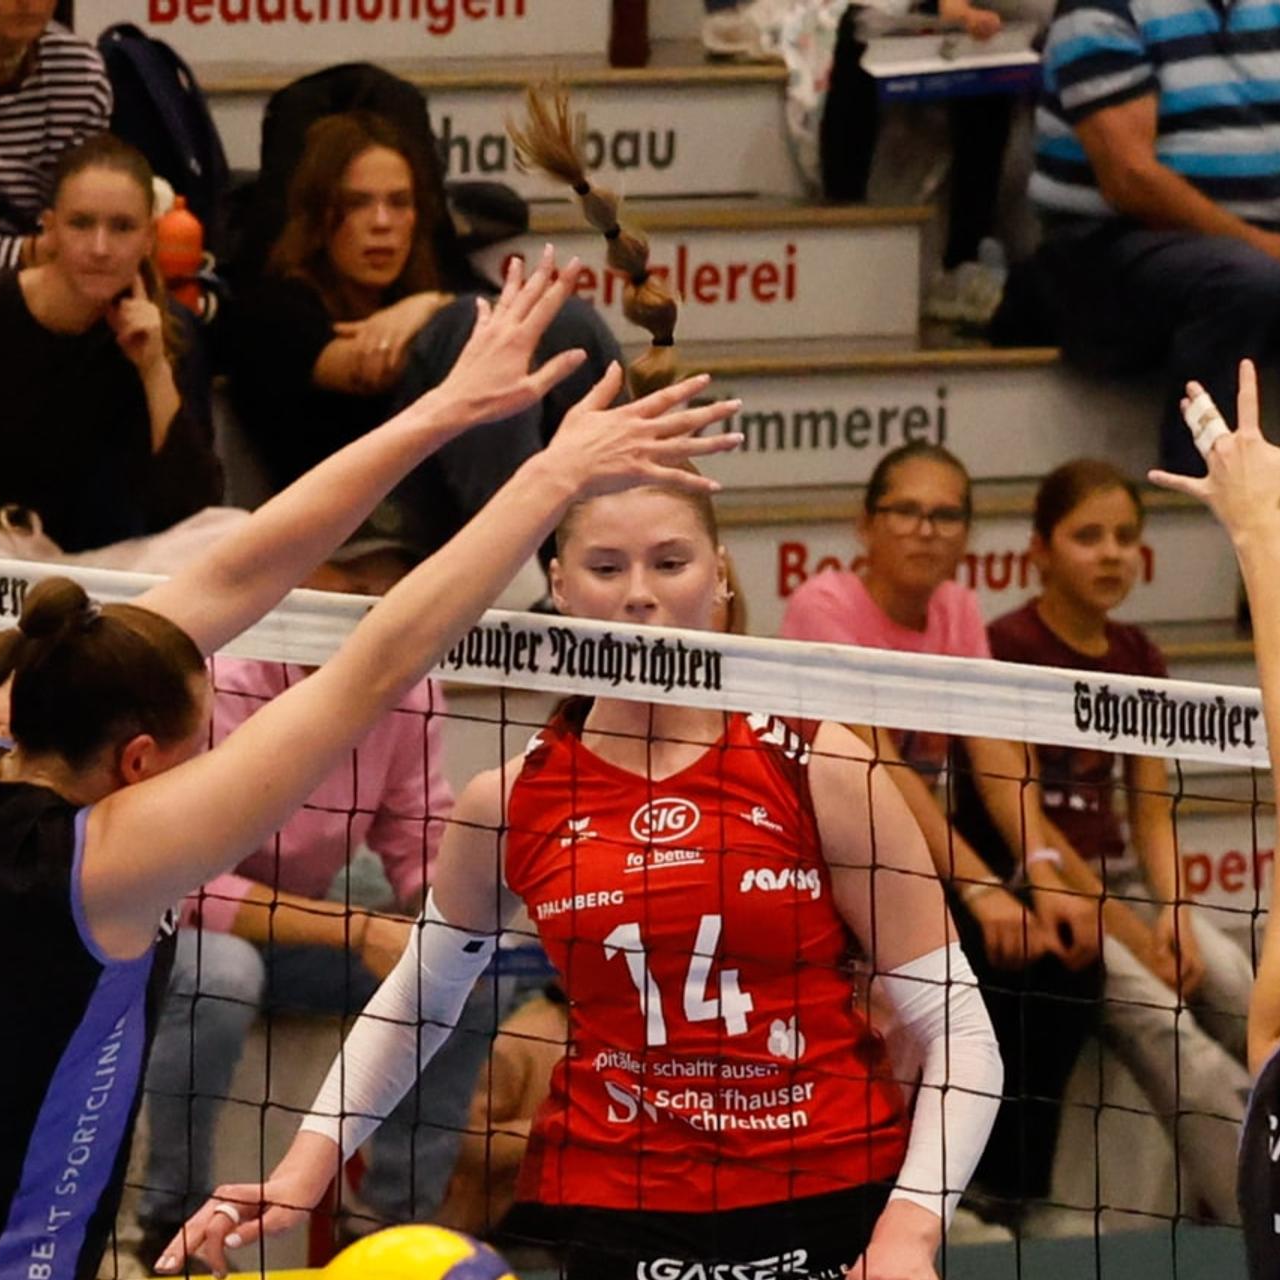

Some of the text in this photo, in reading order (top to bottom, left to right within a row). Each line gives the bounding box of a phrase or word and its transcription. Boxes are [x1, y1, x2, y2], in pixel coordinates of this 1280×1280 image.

[549, 626, 723, 692] Nachrichten
[640, 804, 688, 833] SIG
[603, 914, 753, 1046] 14
[653, 1082, 815, 1112] Schafhauser
[673, 1110, 808, 1132] chrichten
